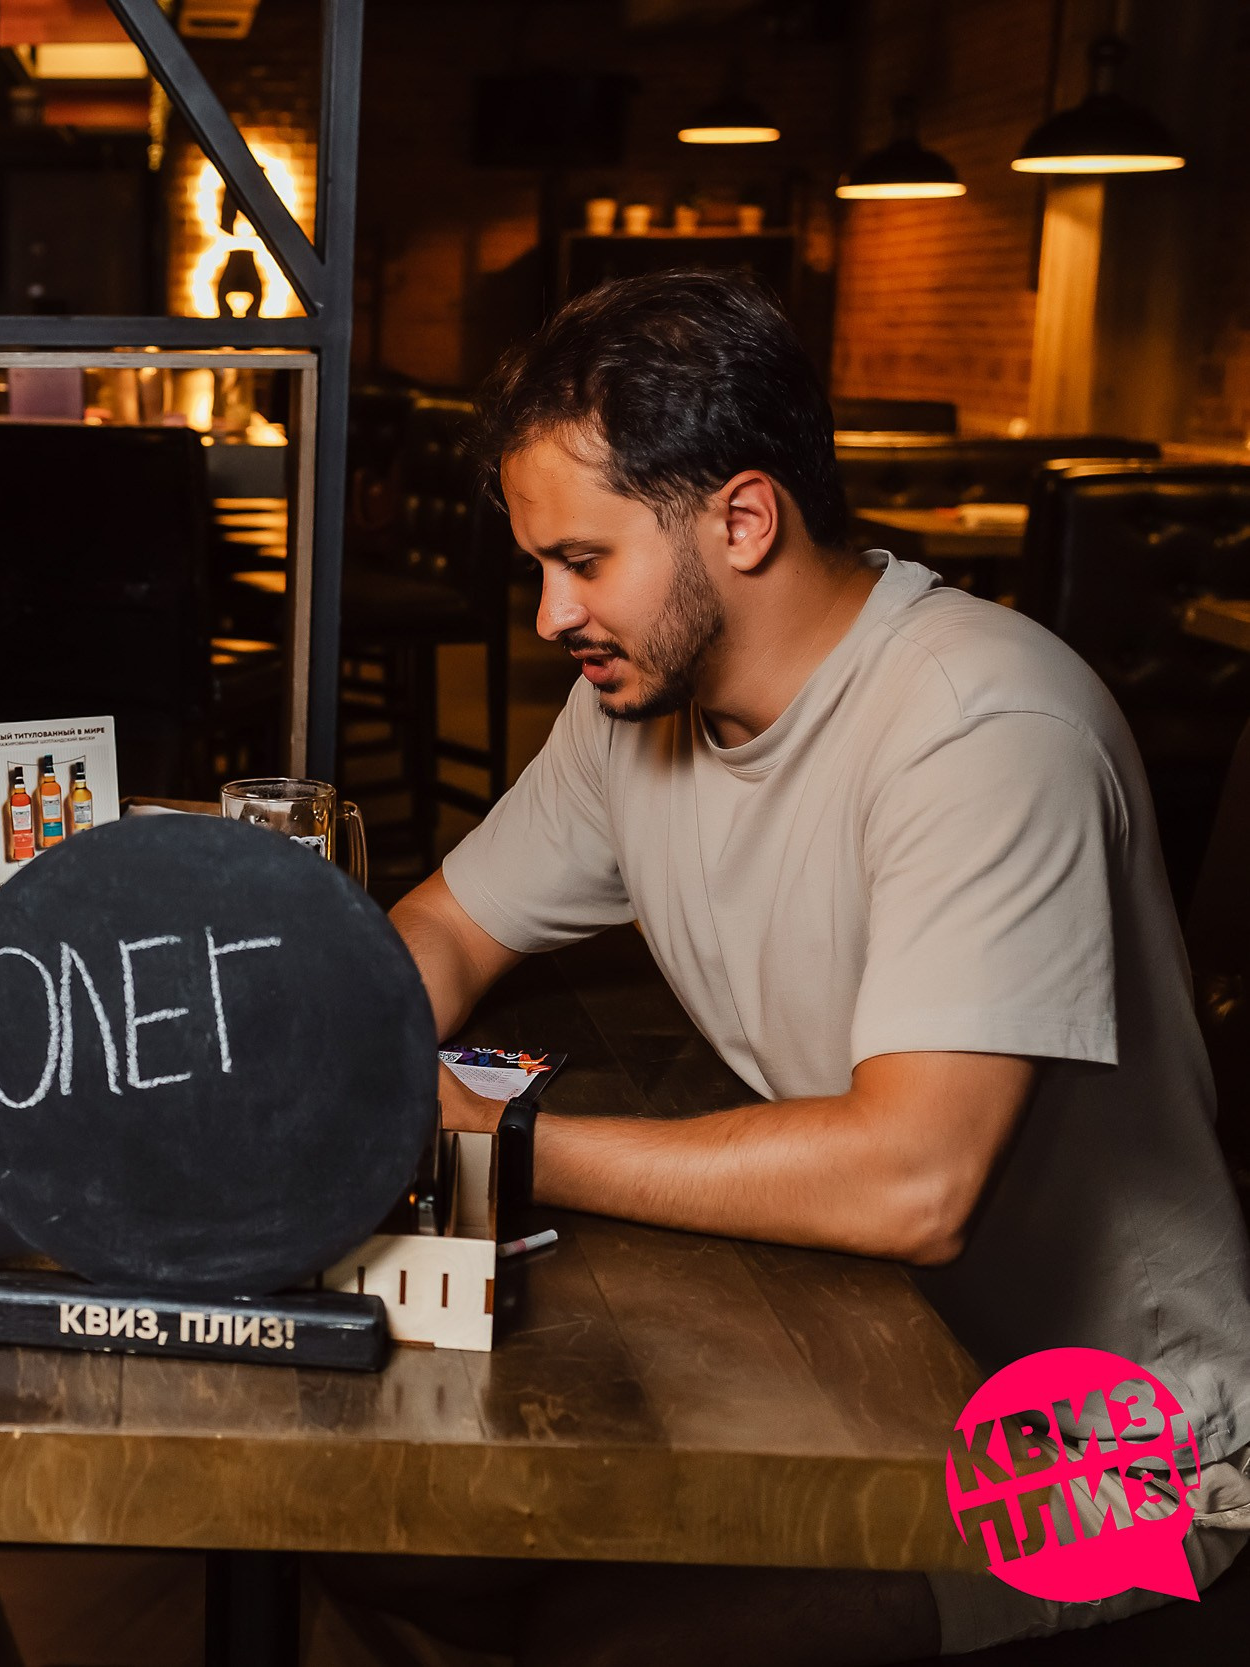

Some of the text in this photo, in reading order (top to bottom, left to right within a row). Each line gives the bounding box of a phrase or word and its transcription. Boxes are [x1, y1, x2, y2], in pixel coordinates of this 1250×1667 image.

[14, 728, 76, 738] ТИТУЛОВАННЫЙ
[84, 726, 106, 735] МИРЕ
[59, 1302, 296, 1350] КВИЗ, ПЛИЗ!
